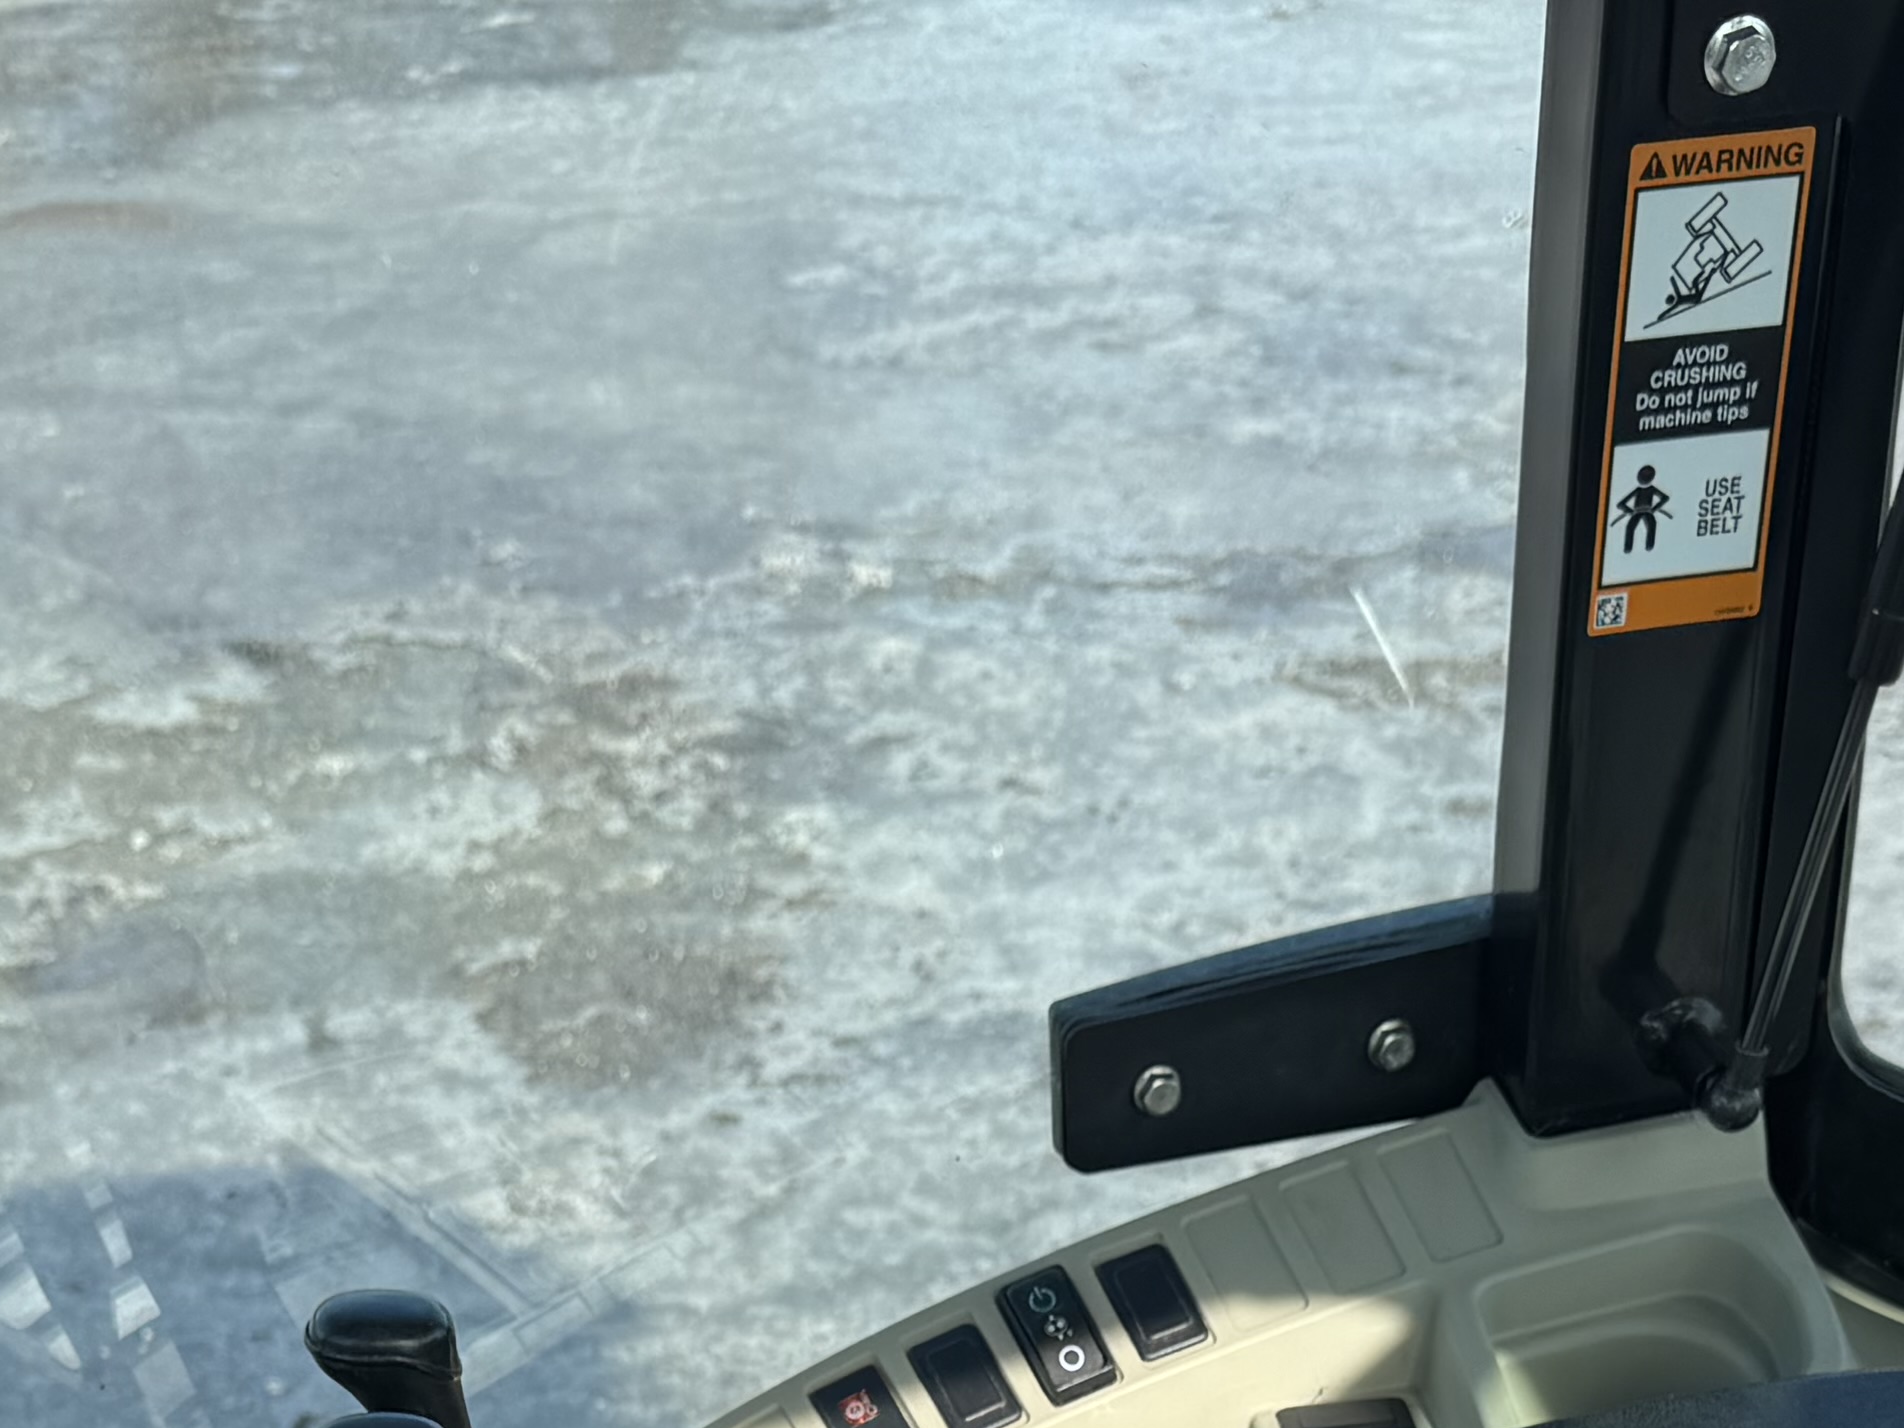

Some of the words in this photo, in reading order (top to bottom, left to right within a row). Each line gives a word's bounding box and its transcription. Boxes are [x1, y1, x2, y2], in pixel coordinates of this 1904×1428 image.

[1672, 142, 1804, 177] WARNING
[1672, 344, 1729, 366] AVOID
[1650, 362, 1746, 389] CRUSHING
[1636, 392, 1660, 411] Do
[1665, 389, 1693, 408] not
[1696, 386, 1742, 409] jump
[1746, 379, 1758, 399] if
[1639, 408, 1712, 431] machine
[1717, 404, 1749, 425] tips
[1705, 476, 1742, 498] USE
[1697, 495, 1746, 518] SEAT
[1696, 514, 1743, 537] BELT
